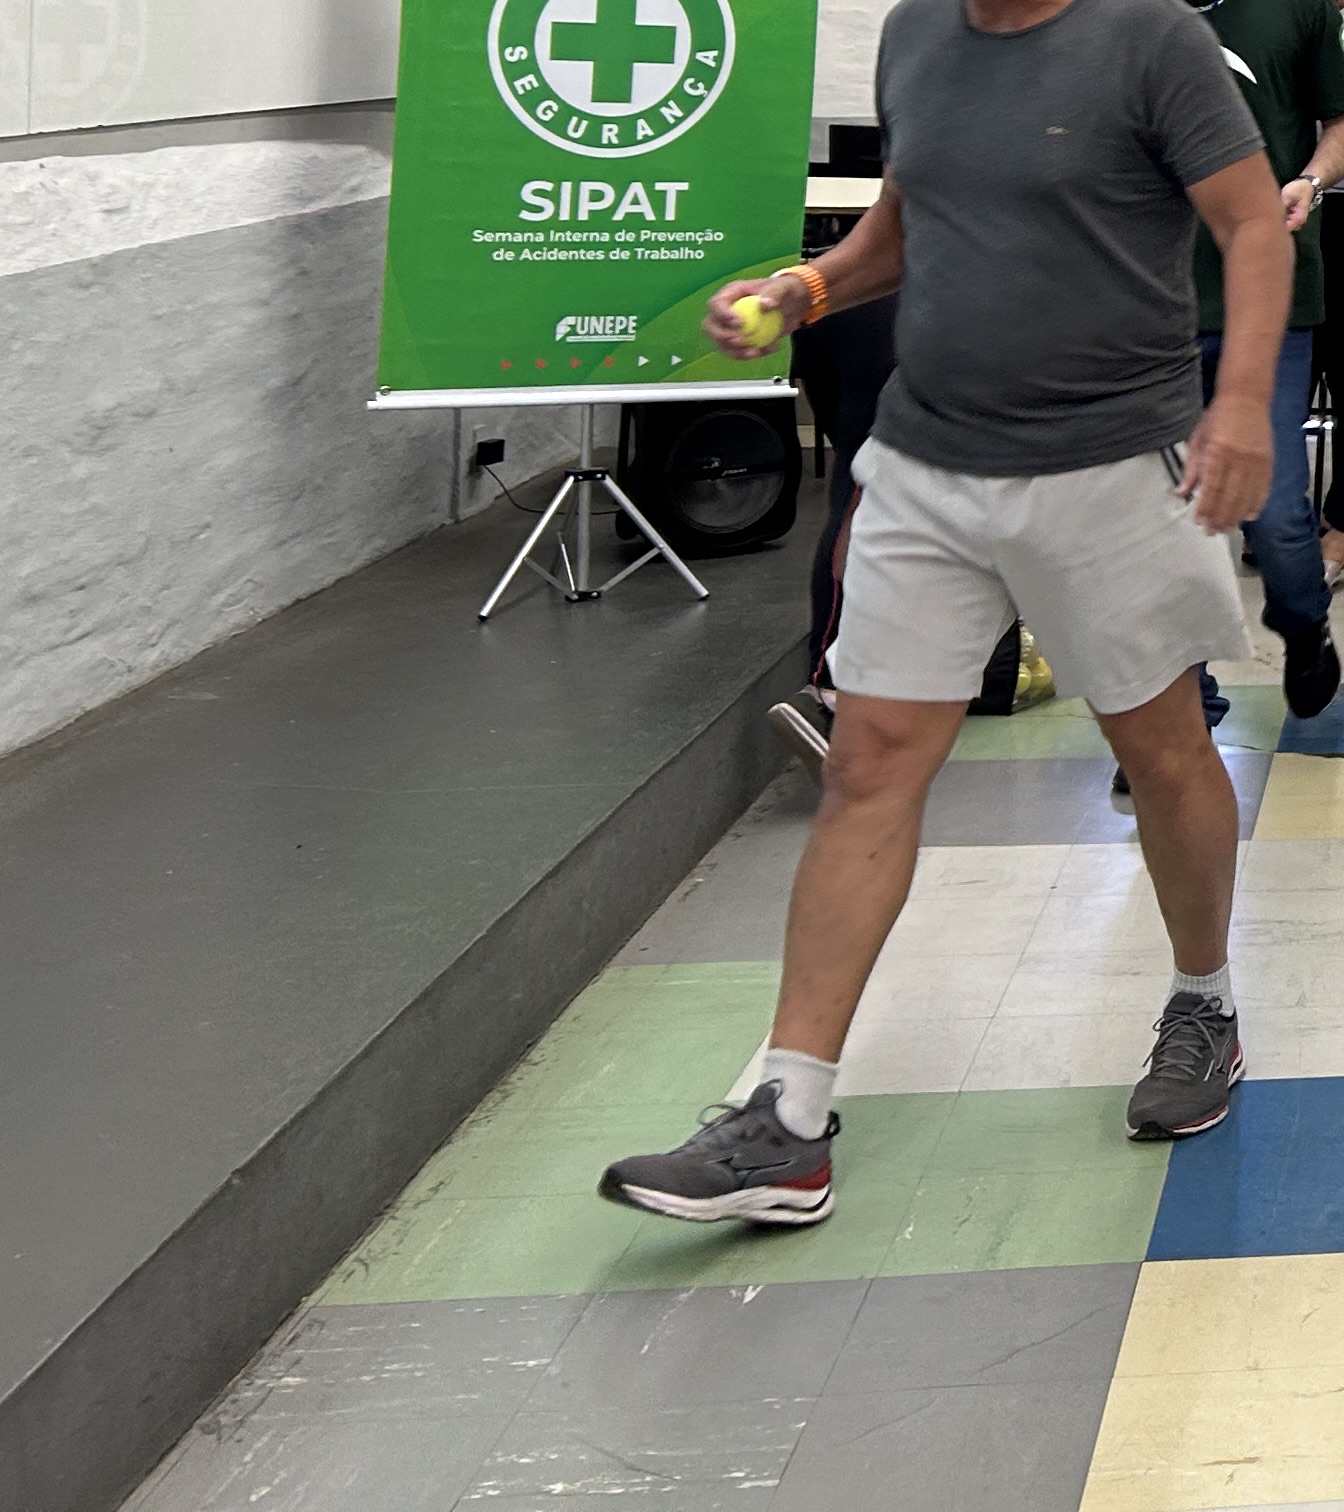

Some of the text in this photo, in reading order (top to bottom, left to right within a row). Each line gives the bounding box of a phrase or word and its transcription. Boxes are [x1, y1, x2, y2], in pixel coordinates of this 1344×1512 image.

[504, 45, 719, 144] SEGURANÇA
[518, 180, 690, 222] SIPAT
[472, 228, 724, 245] Semana Interna de Prevenção
[492, 246, 705, 261] de Acidentes de Trabalho
